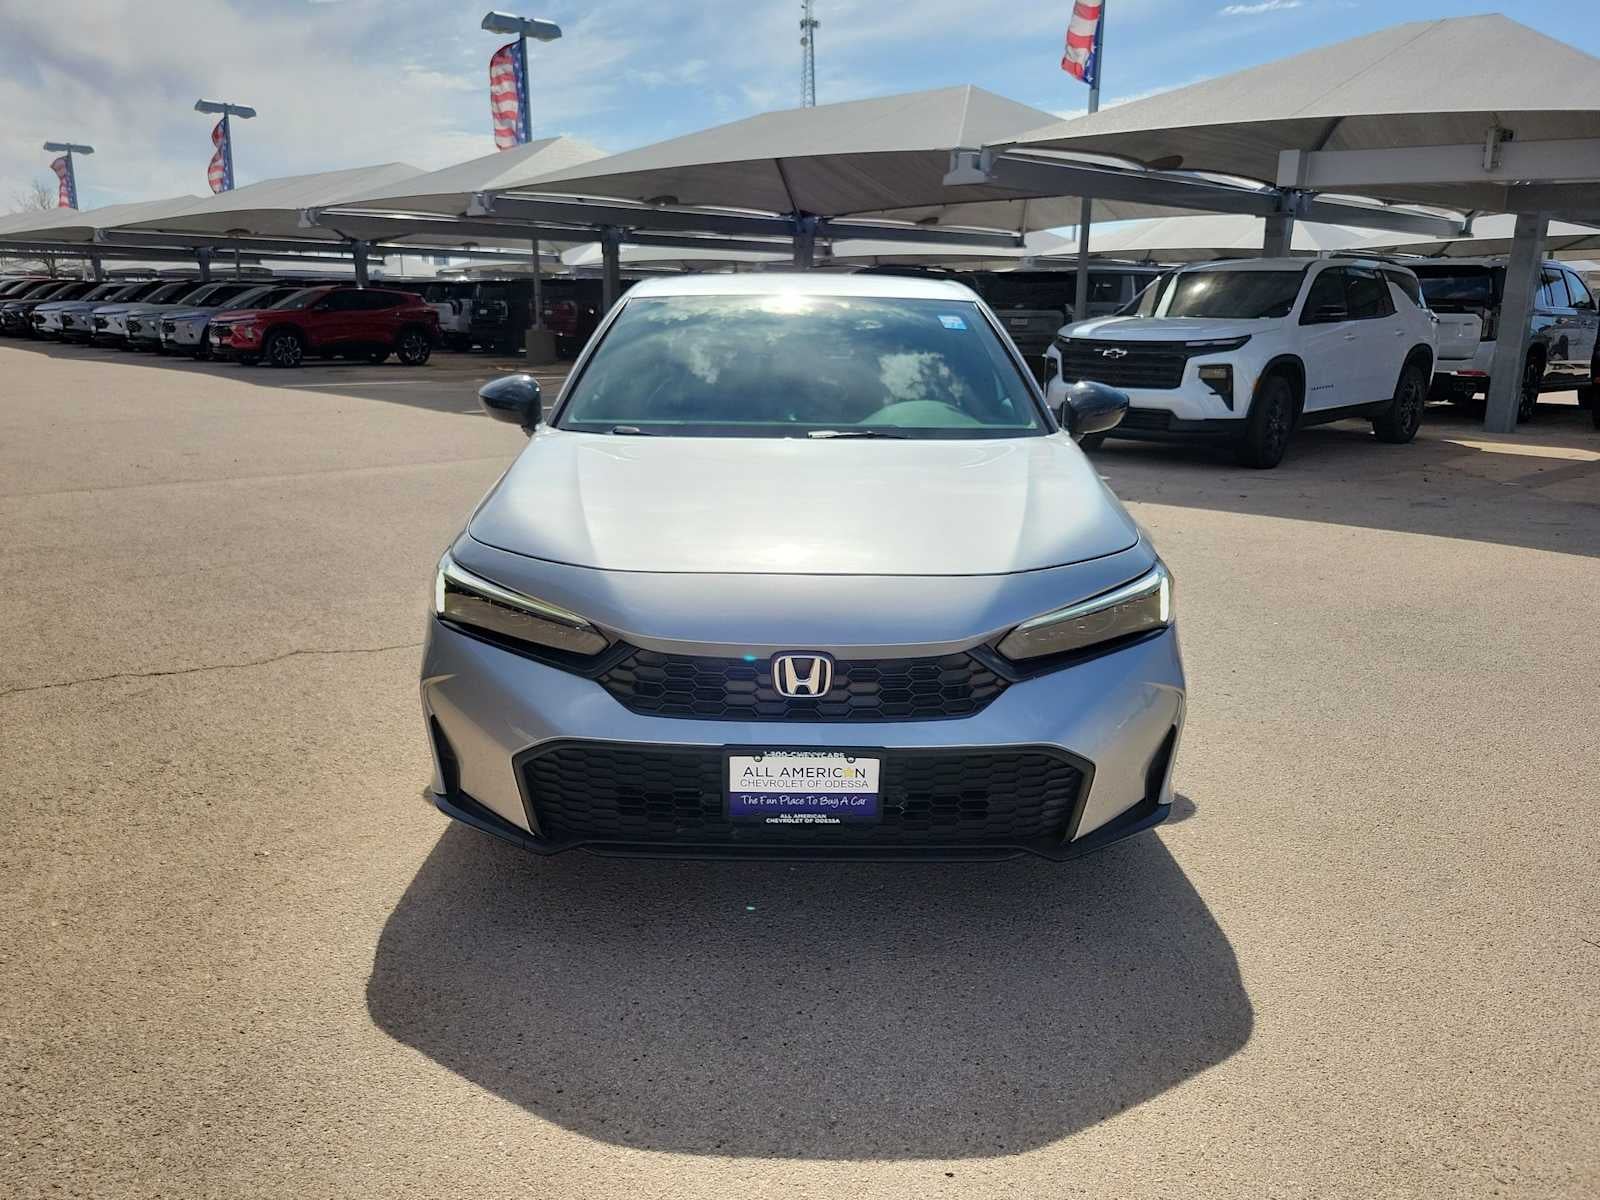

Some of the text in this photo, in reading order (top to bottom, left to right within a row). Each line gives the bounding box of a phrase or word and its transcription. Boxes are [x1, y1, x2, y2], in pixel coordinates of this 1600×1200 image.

[743, 767, 866, 778] ALL AMERICN
[740, 779, 869, 789] CHEVROLET OF ODESSA
[740, 795, 757, 805] The
[779, 795, 805, 805] Place
[806, 795, 818, 805] To
[820, 796, 839, 808] Buy
[840, 796, 849, 805] A
[850, 796, 867, 806] Car
